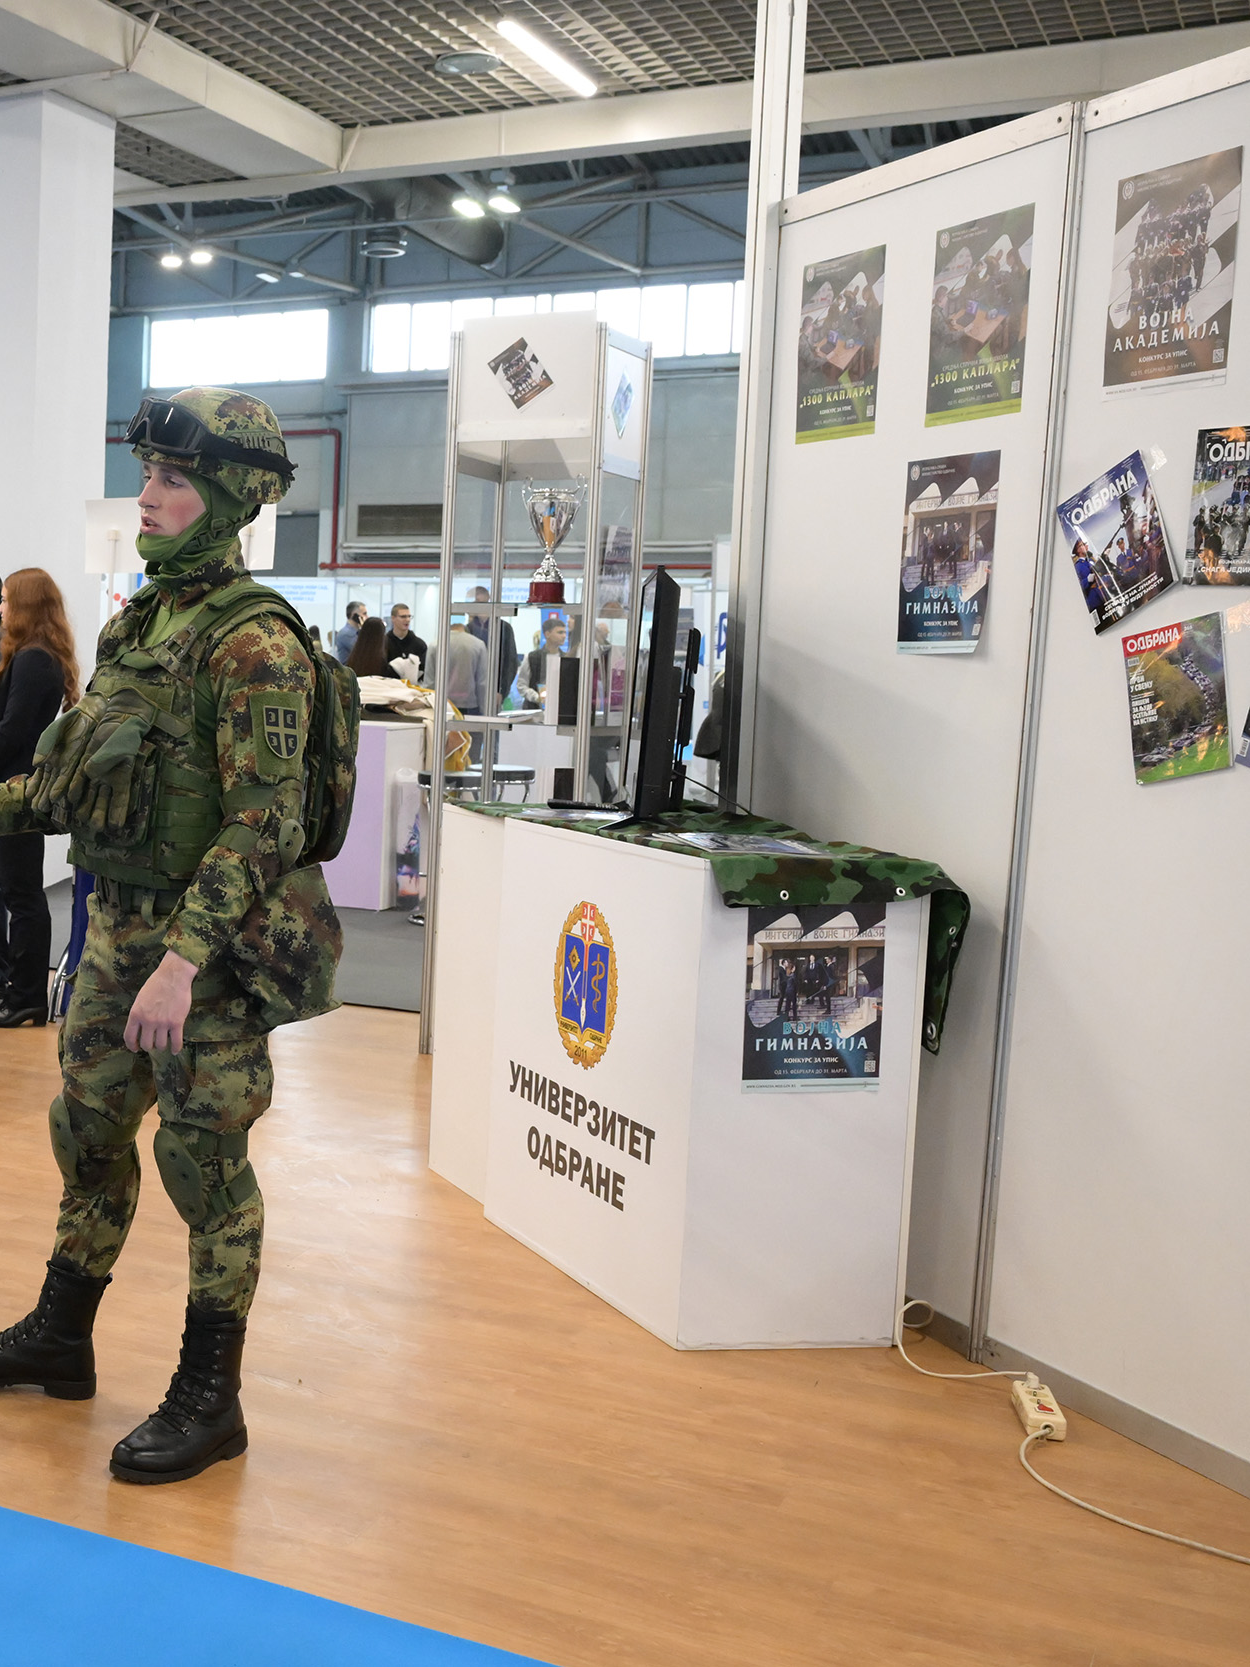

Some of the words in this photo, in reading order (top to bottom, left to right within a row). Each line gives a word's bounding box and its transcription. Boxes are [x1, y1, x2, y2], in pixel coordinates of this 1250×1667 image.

[1138, 307, 1194, 331] ВОЈНА
[1113, 320, 1220, 353] АКАДЕМИЈА
[1138, 354, 1164, 363] КОНКУРС
[1172, 349, 1188, 358] УПИС
[931, 371, 958, 388] „1300
[962, 358, 1020, 380] КАПЛАРА“
[799, 394, 823, 409] „1300
[826, 385, 874, 402] КАПЛАРА“
[1209, 441, 1250, 462] ОДБ
[1071, 469, 1138, 525] ОДБРАНА
[1227, 566, 1250, 574] ЈЕДИ
[924, 585, 963, 600] ВОЈНА
[906, 600, 978, 615] ГИМНАЗИЈА
[1126, 627, 1180, 653] ОДБРАНА
[783, 1020, 842, 1036] ВОЈНА
[573, 1045, 588, 1059] 2011
[755, 1036, 868, 1051] ГИМНАЗИЈА
[509, 1059, 656, 1166] УНИВЕРЗИТЕТ
[527, 1125, 626, 1212] ОДБРАНЕ
